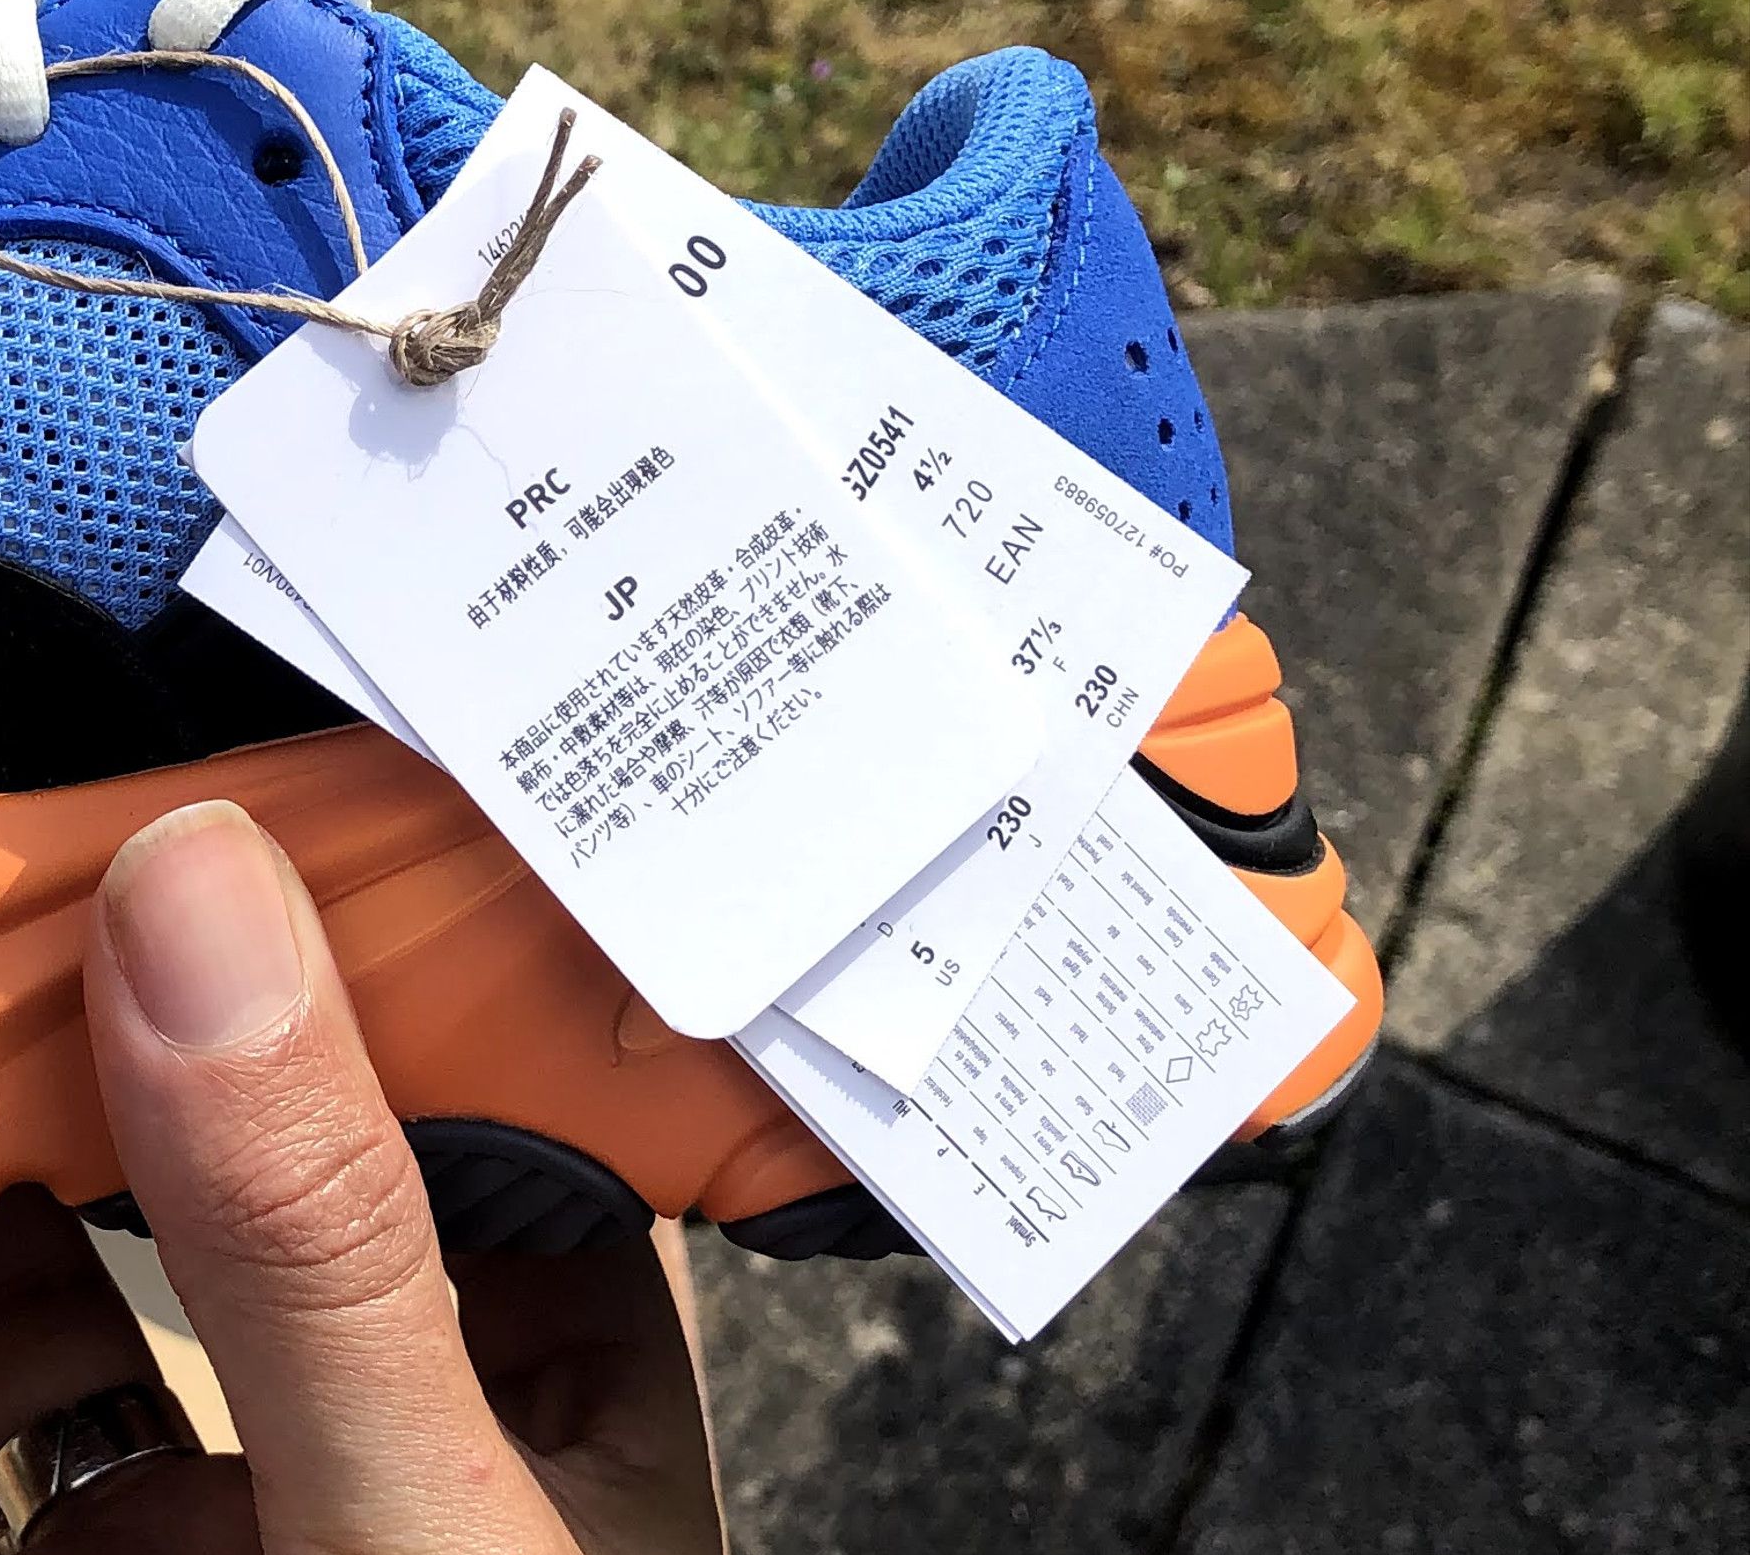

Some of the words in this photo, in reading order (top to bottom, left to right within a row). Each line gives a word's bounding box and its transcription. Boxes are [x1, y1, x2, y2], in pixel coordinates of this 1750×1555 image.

[504, 467, 571, 530] PRC
[941, 480, 993, 538] 720
[1054, 476, 1146, 547] 127059883
[984, 513, 1044, 585] EAN
[1149, 544, 1189, 578] PO#
[604, 576, 638, 621] JP
[1053, 656, 1066, 672] F
[1075, 665, 1117, 718] 230
[1106, 687, 1139, 728] CHN
[671, 688, 822, 815] 十分にご注意ください。
[986, 795, 1031, 851] 230
[1029, 834, 1042, 848] J
[876, 920, 895, 938] D
[911, 941, 935, 964] 5
[935, 959, 960, 986] US
[891, 1097, 911, 1118] HU
[937, 1147, 949, 1157] P
[973, 1183, 986, 1195] E
[1005, 1215, 1036, 1248] Symbol
